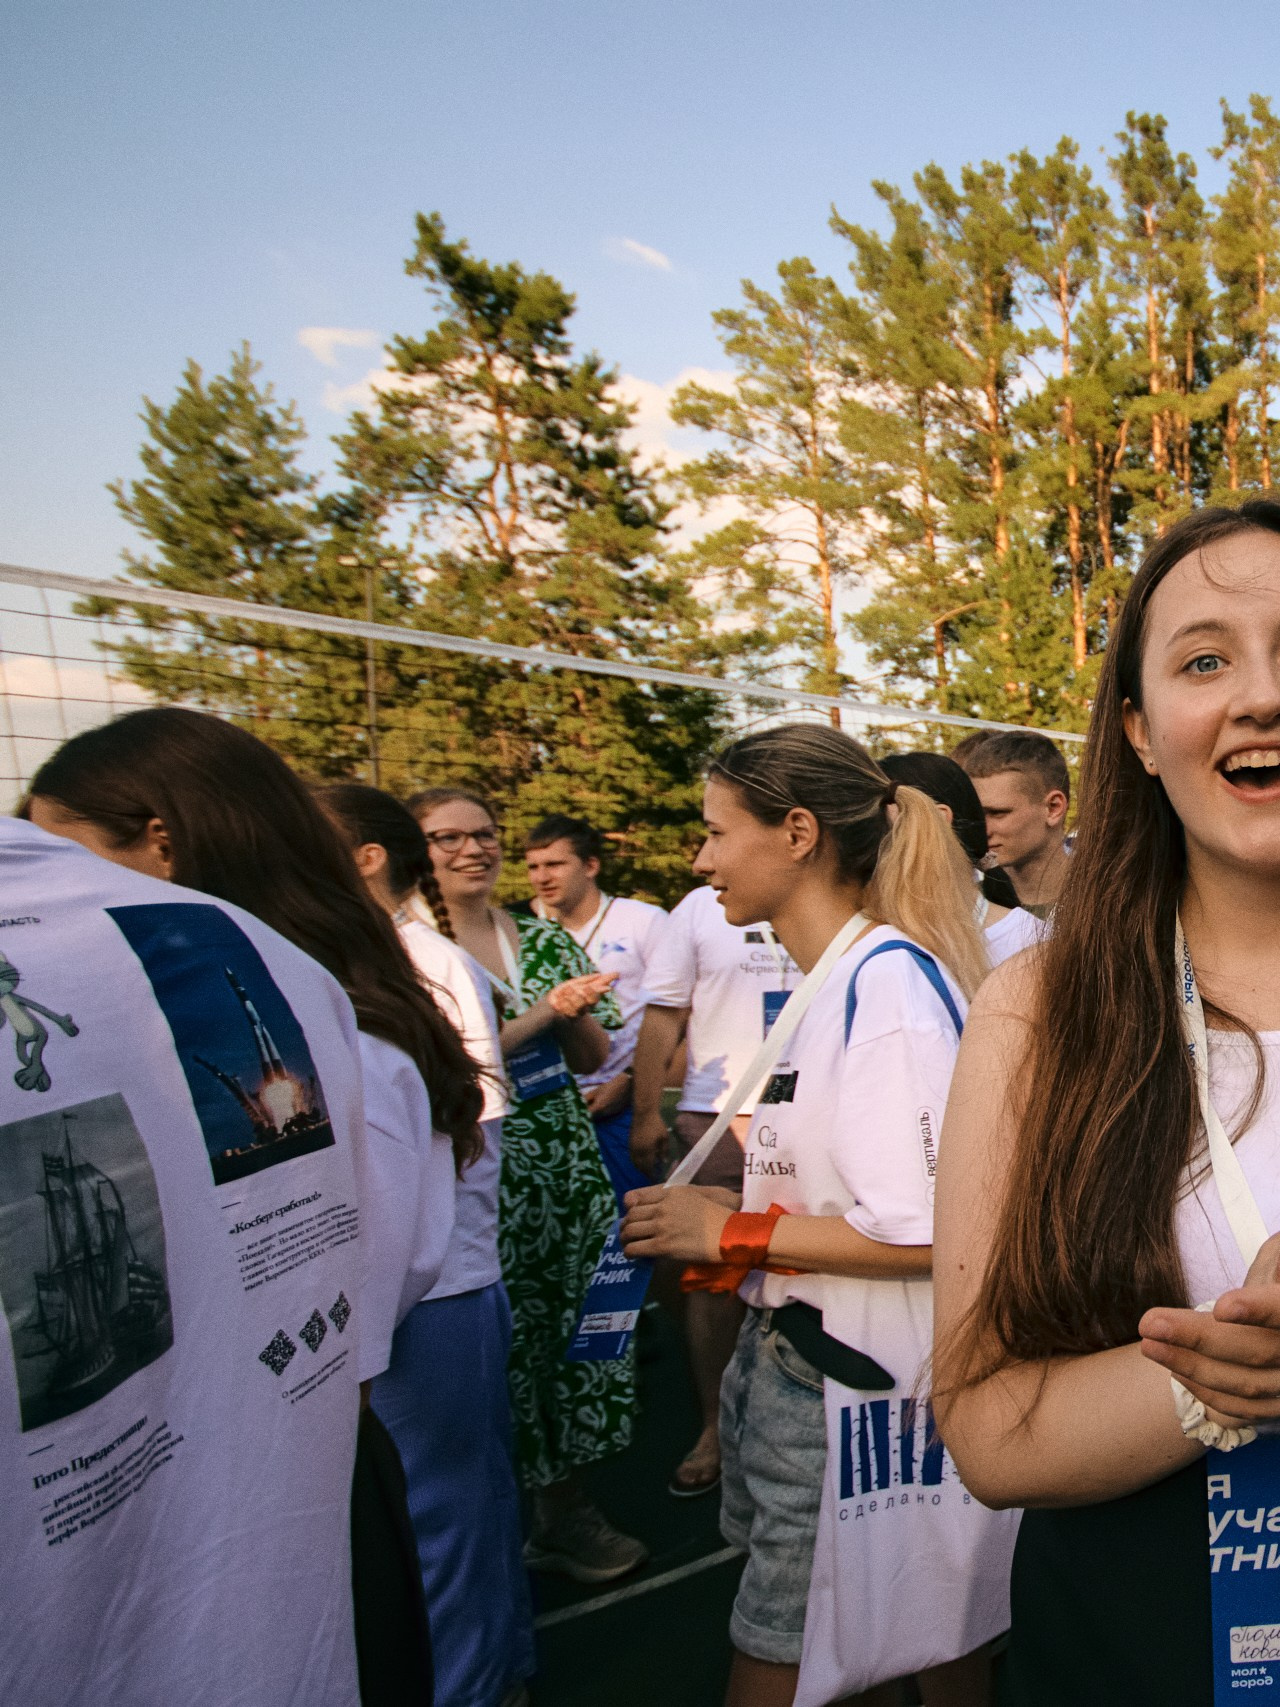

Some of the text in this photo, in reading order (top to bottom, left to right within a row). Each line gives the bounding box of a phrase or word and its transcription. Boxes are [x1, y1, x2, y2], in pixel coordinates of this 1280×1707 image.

[920, 1112, 937, 1176] вертикаль
[839, 1493, 941, 1521] сделано
[1231, 1668, 1258, 1677] мол
[1231, 1676, 1273, 1689] город
